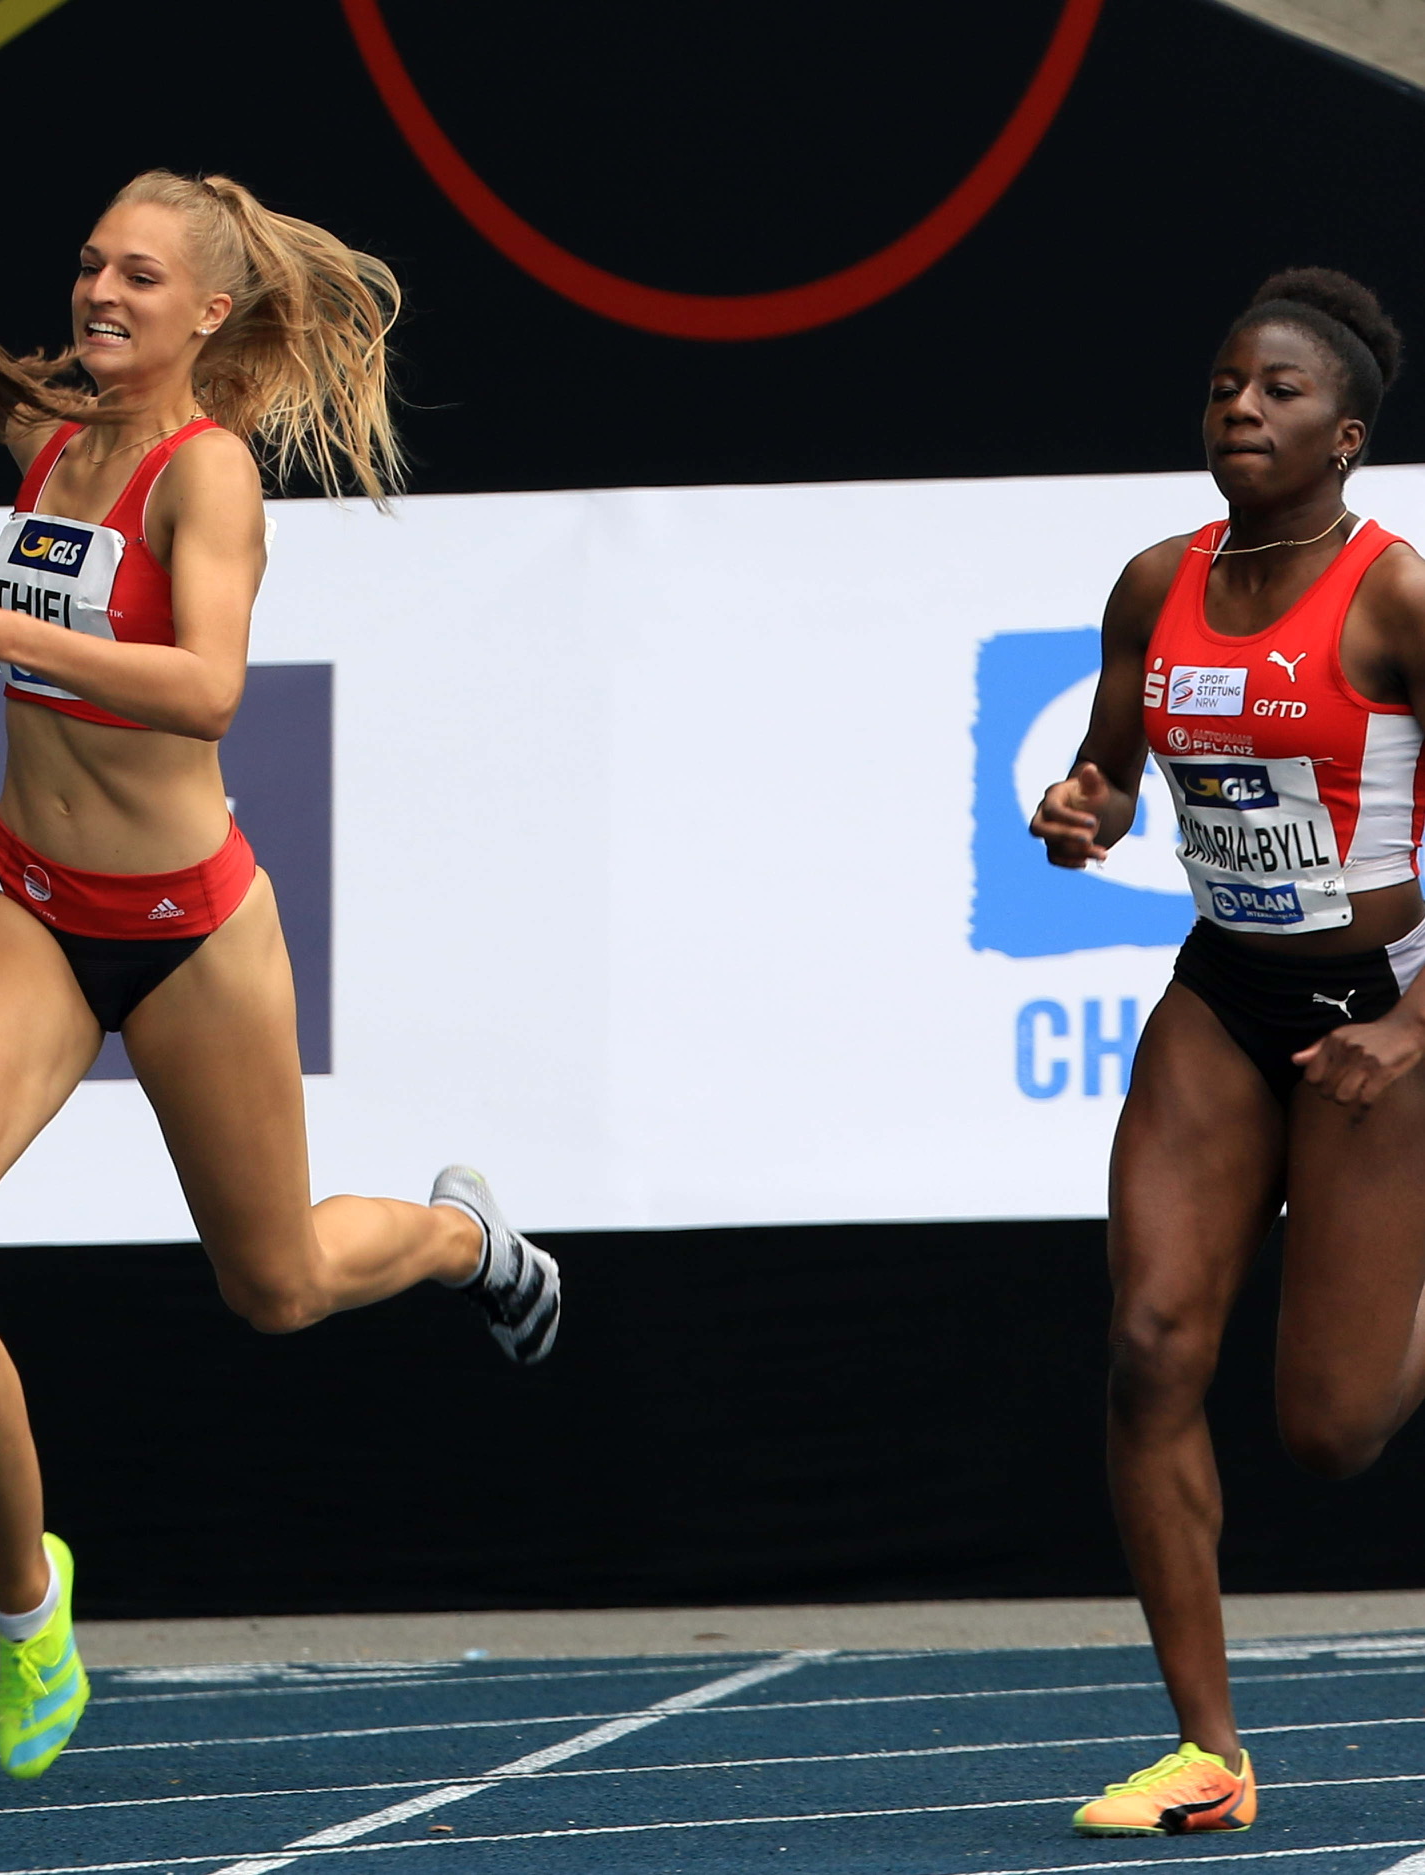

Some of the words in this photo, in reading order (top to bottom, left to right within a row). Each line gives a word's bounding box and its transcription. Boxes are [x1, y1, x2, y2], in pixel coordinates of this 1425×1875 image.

[48, 540, 82, 566] GLS
[1199, 674, 1230, 685] SPORT
[1196, 685, 1241, 697] STIFTUNG
[1195, 697, 1219, 708] NRW
[1252, 698, 1307, 718] GfTD
[1192, 729, 1253, 746] AUTOHAUS
[1193, 740, 1255, 756] PFLANZ
[1221, 777, 1266, 802] GLS
[1239, 891, 1295, 912] PLAN
[148, 908, 185, 920] adidas
